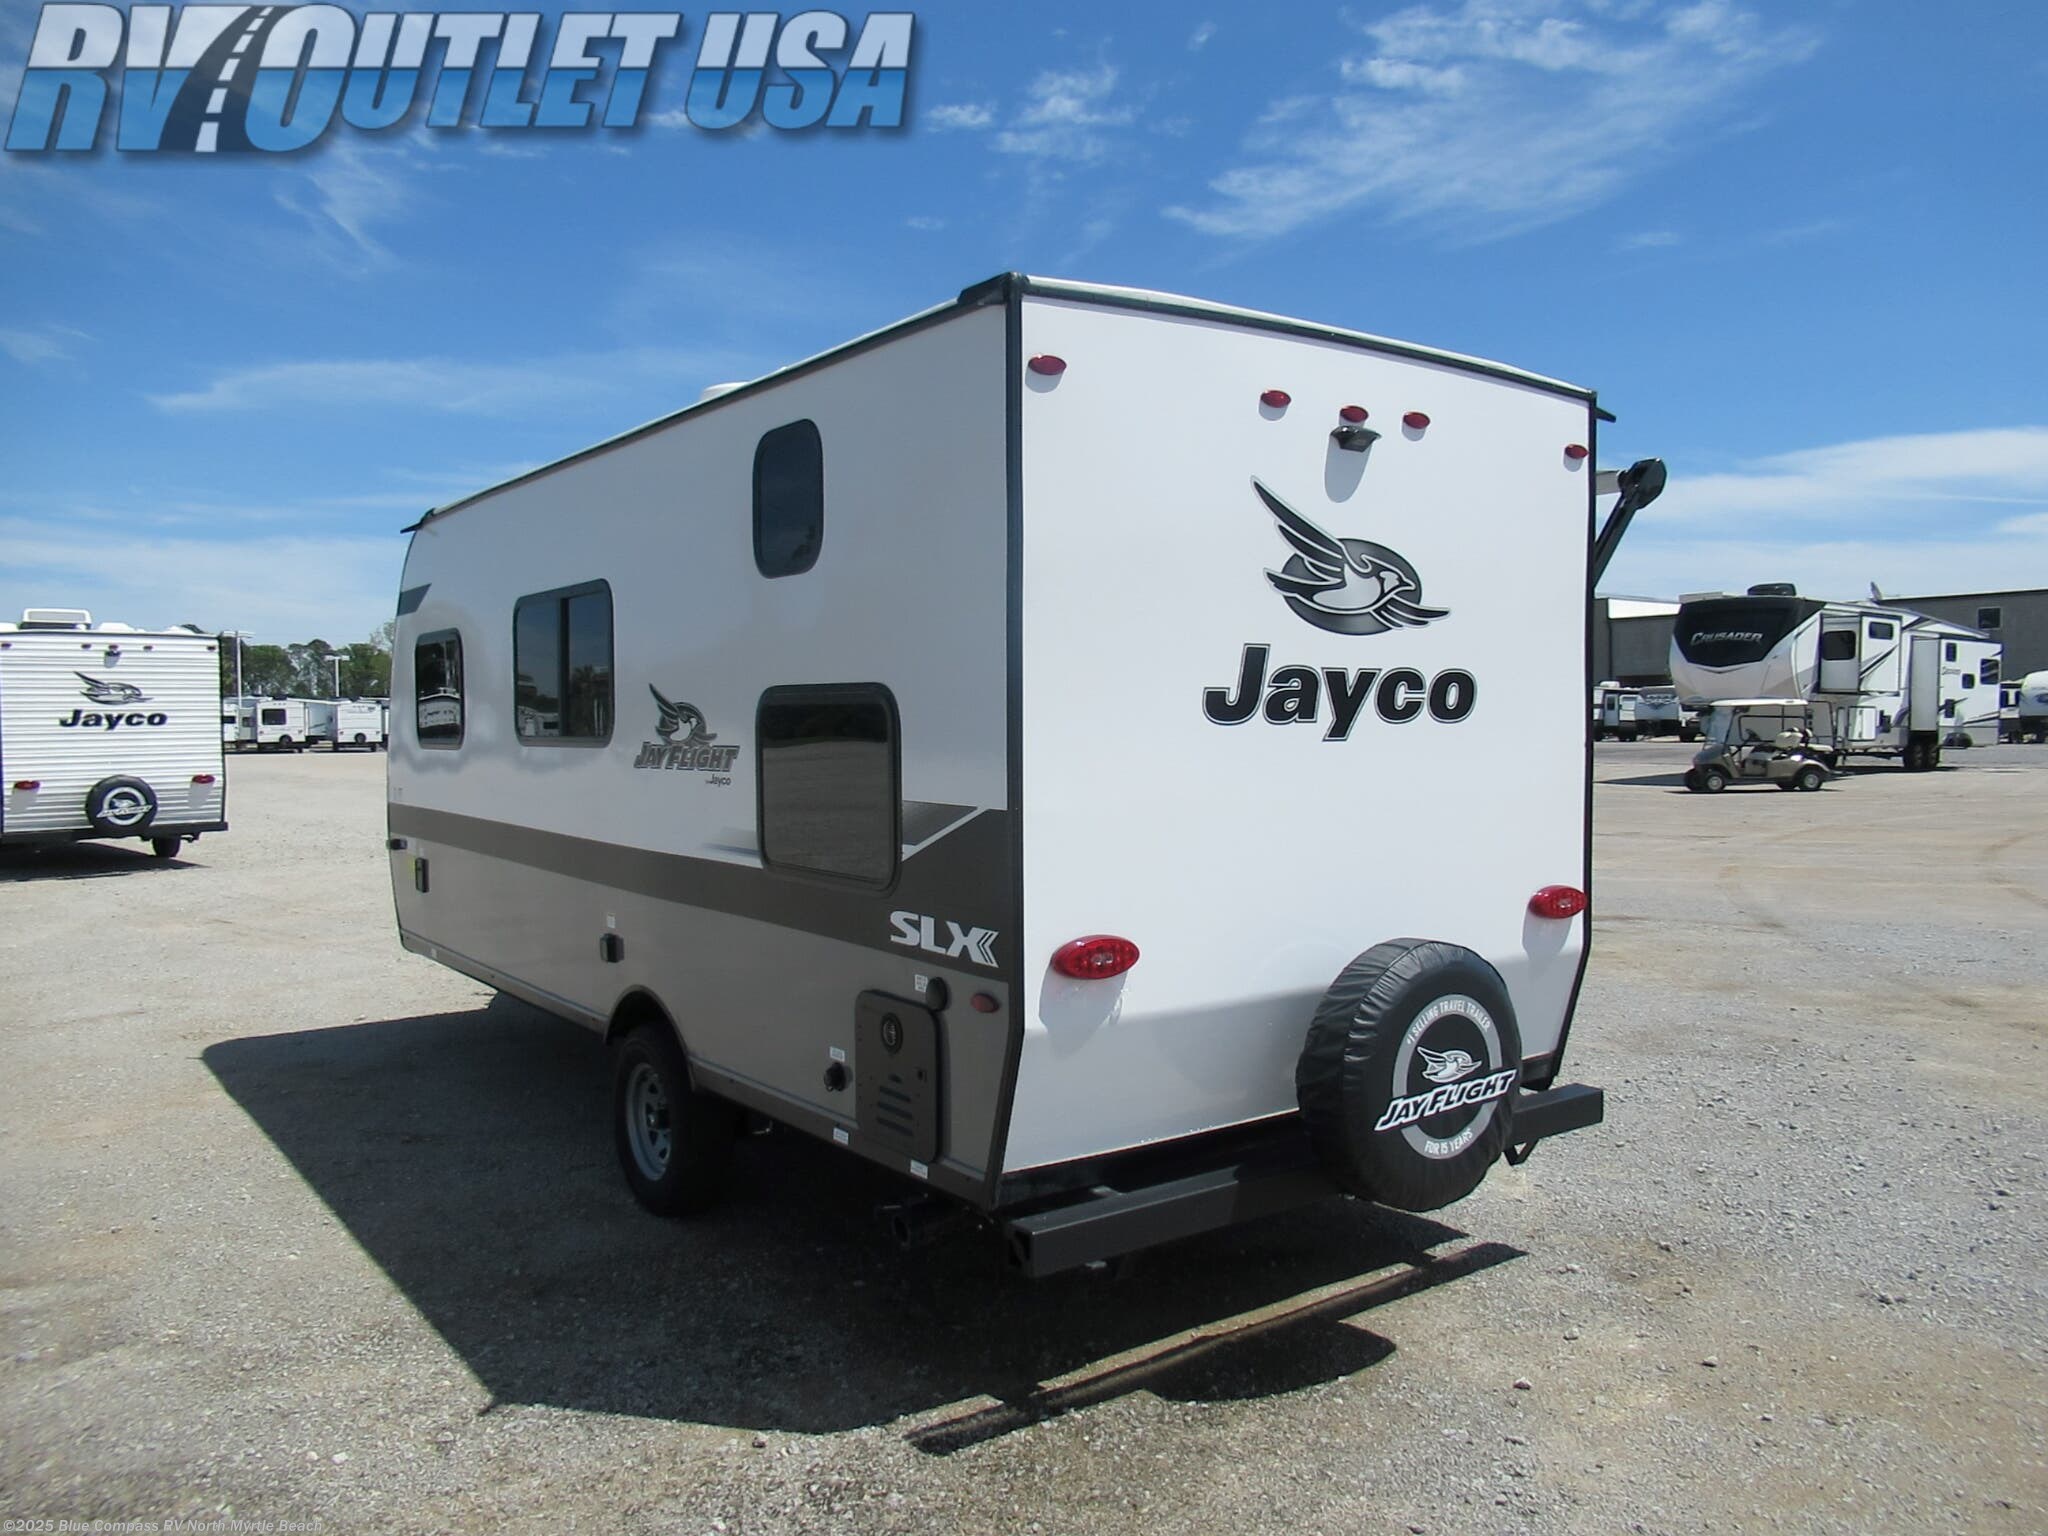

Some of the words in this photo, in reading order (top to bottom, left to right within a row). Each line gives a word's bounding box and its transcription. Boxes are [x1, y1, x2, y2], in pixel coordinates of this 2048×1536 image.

[1690, 632, 1763, 646] CRUSADER
[1202, 643, 1478, 742] Jayco
[59, 709, 168, 731] Jayco
[889, 910, 1000, 969] SLX
[1412, 1006, 1439, 1037] SELLING
[1440, 1000, 1465, 1014] TRAVEL
[1466, 1002, 1491, 1033] TRAILER
[1424, 1140, 1440, 1155] FOR
[1448, 1128, 1473, 1152] YEARS
